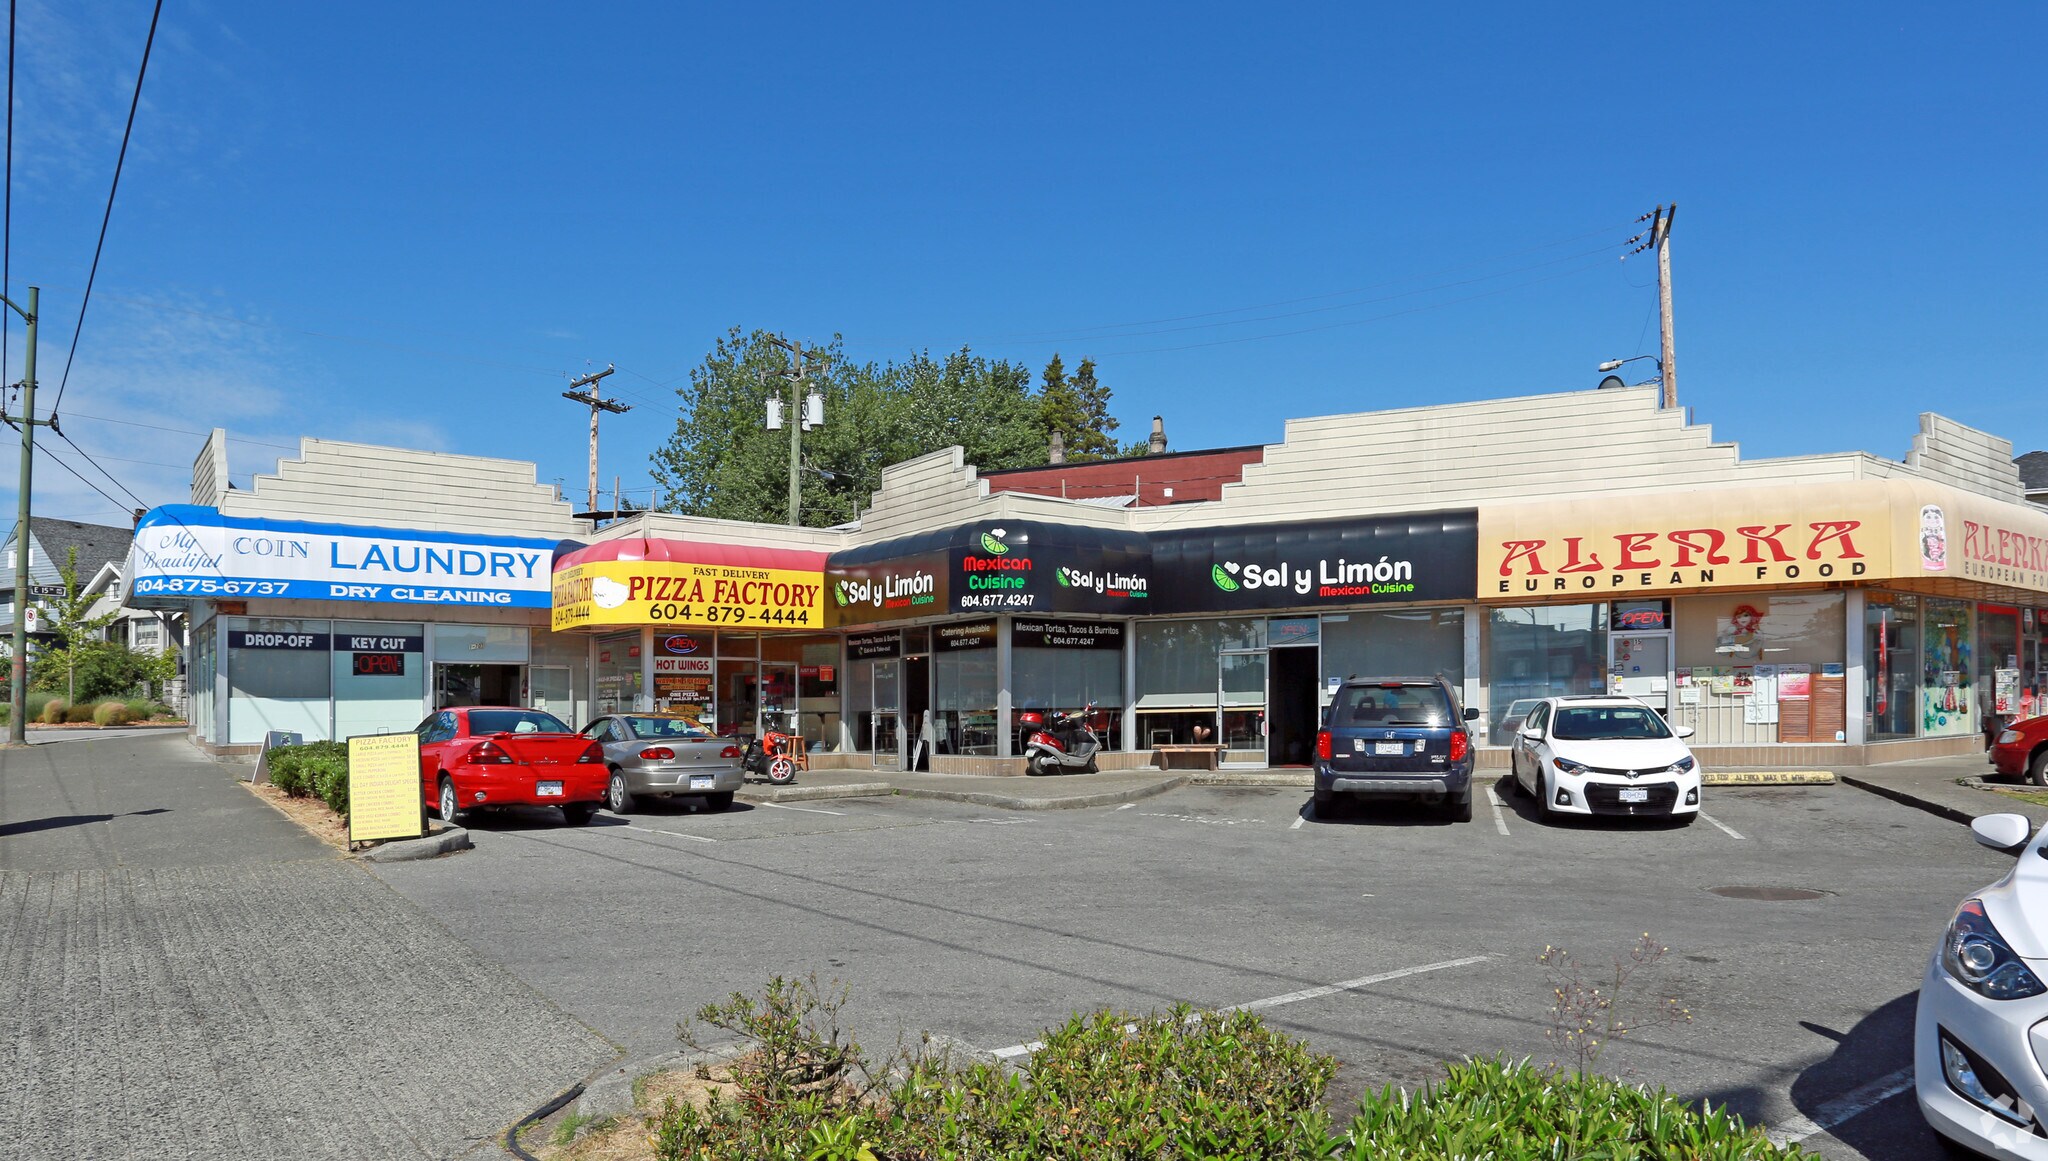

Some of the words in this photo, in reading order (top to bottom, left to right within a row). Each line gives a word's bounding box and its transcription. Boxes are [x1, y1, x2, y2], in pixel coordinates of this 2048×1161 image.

[160, 531, 196, 551] My
[233, 536, 310, 558] COIN
[1500, 520, 1865, 577] ALENKA
[1964, 520, 2048, 572] ALENK
[142, 551, 223, 572] Beautiful
[330, 541, 540, 578] LAUNDRY
[963, 555, 1032, 572] Mexican
[693, 567, 717, 576] FAST
[722, 569, 770, 580] DELIVERY
[969, 574, 1025, 590] Cuisine
[1071, 570, 1093, 588] Sal
[1095, 576, 1104, 594] y
[1106, 572, 1147, 591] Limón
[1243, 562, 1288, 589] Sal
[1294, 568, 1312, 594] y
[1320, 556, 1412, 586] Limón
[1499, 570, 1714, 593] EUROPEAN
[1756, 562, 1866, 580] FOOD
[1965, 561, 2024, 584] EUROPEAN
[2033, 574, 2048, 587] FO
[136, 578, 290, 595] 604-875-6737
[330, 584, 382, 598] DRY
[390, 588, 511, 604] CLEANING
[628, 576, 704, 602] PIZZA
[712, 579, 820, 608] FACTORY
[848, 578, 871, 603] Sal
[873, 584, 883, 608] y
[886, 570, 934, 598] Limón
[1106, 590, 1129, 598] Mexican
[1320, 586, 1370, 597] Mexican
[1371, 582, 1414, 594] Cuisine
[886, 599, 911, 609] Mexican
[911, 594, 934, 606] Cuisine
[961, 594, 1034, 607] 604.677.4247
[649, 603, 808, 625] 604-879-4444
[1622, 612, 1664, 624] OPEN
[941, 629, 964, 638] Catering
[964, 624, 990, 635] Available
[1016, 622, 1044, 632] Mexican
[1045, 624, 1068, 634] Tortas,
[1068, 625, 1087, 634] Tacos
[1094, 626, 1119, 635] Burritos
[245, 634, 314, 648] DROP-OFF
[351, 637, 376, 649] KEY
[380, 638, 406, 650] CUT
[667, 638, 697, 648] OPEN
[950, 638, 980, 648] 604.677.4247
[1053, 637, 1094, 645] 604.677.4247
[358, 655, 398, 673] OPEN
[656, 660, 675, 670] HOT
[678, 660, 710, 671] WINGS
[379, 736, 411, 744] FACTORY
